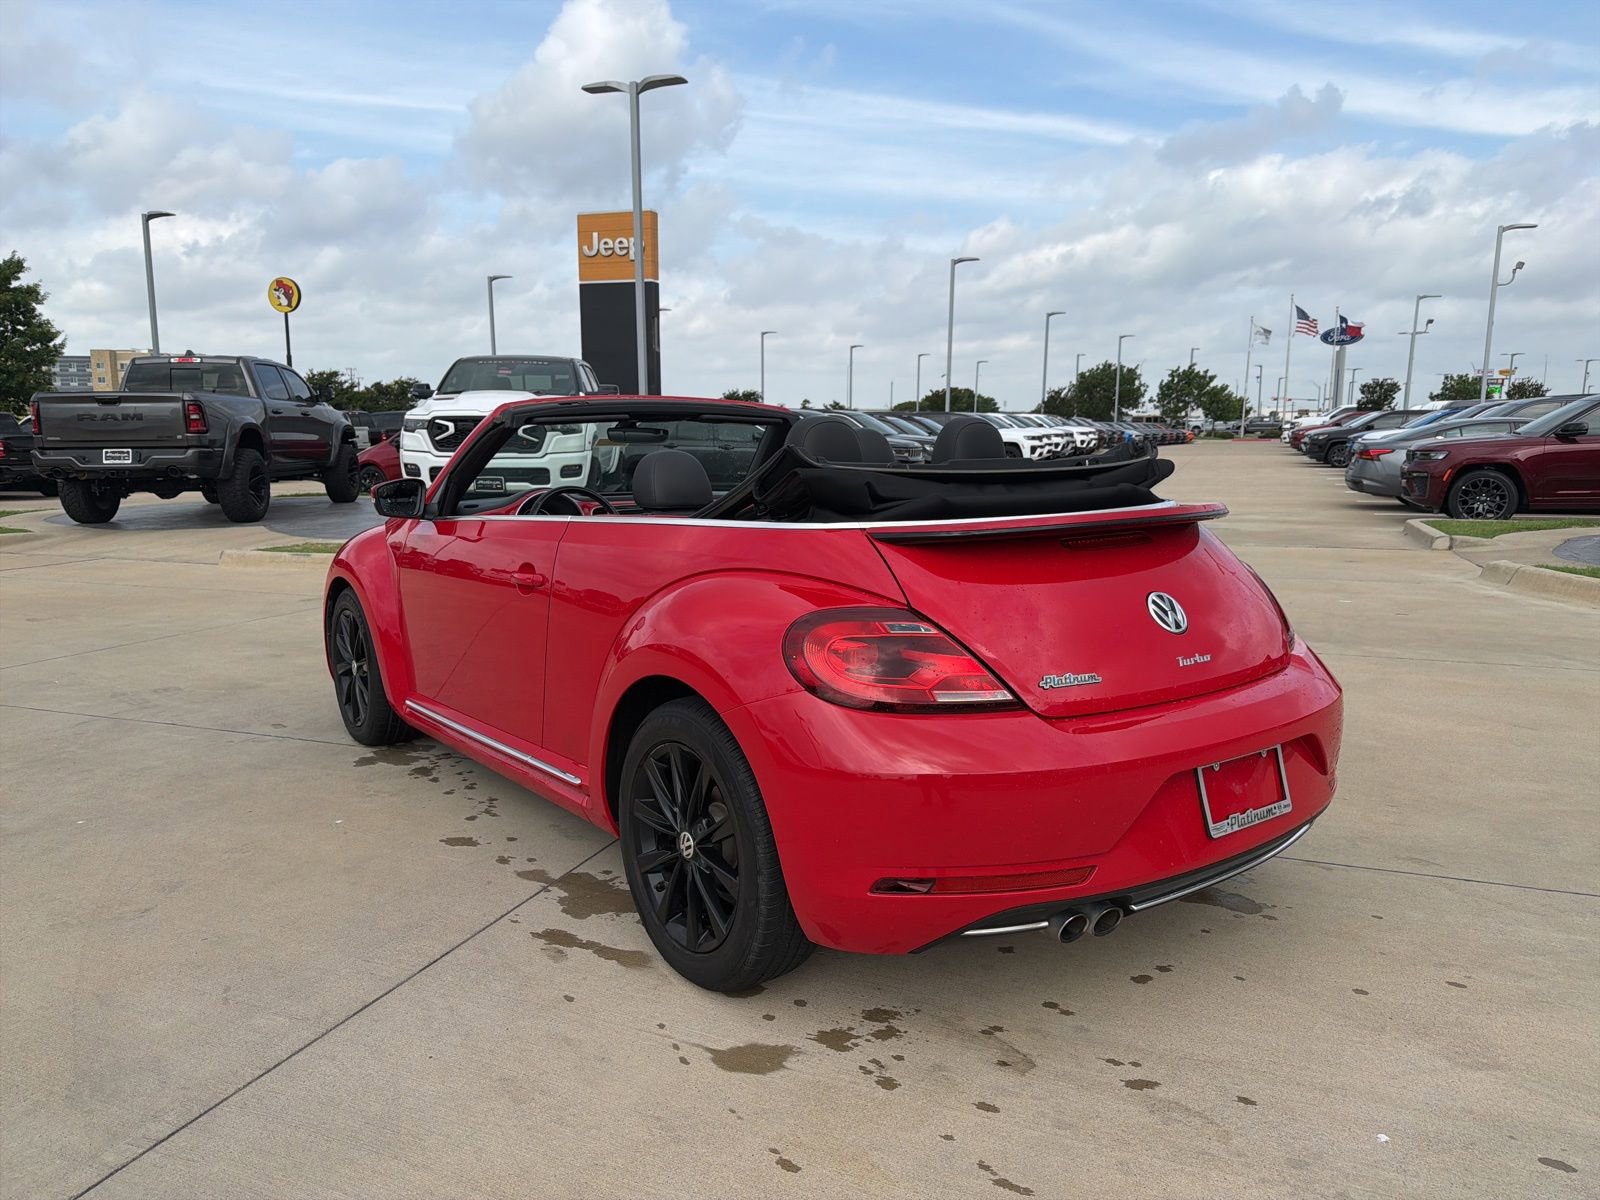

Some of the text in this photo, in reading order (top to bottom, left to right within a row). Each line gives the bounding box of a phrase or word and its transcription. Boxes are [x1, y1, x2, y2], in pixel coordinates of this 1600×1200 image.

[77, 412, 144, 422] RAM
[1176, 653, 1211, 667] Turbo
[1040, 673, 1102, 689] Platinum
[1229, 807, 1277, 830] Platinum
